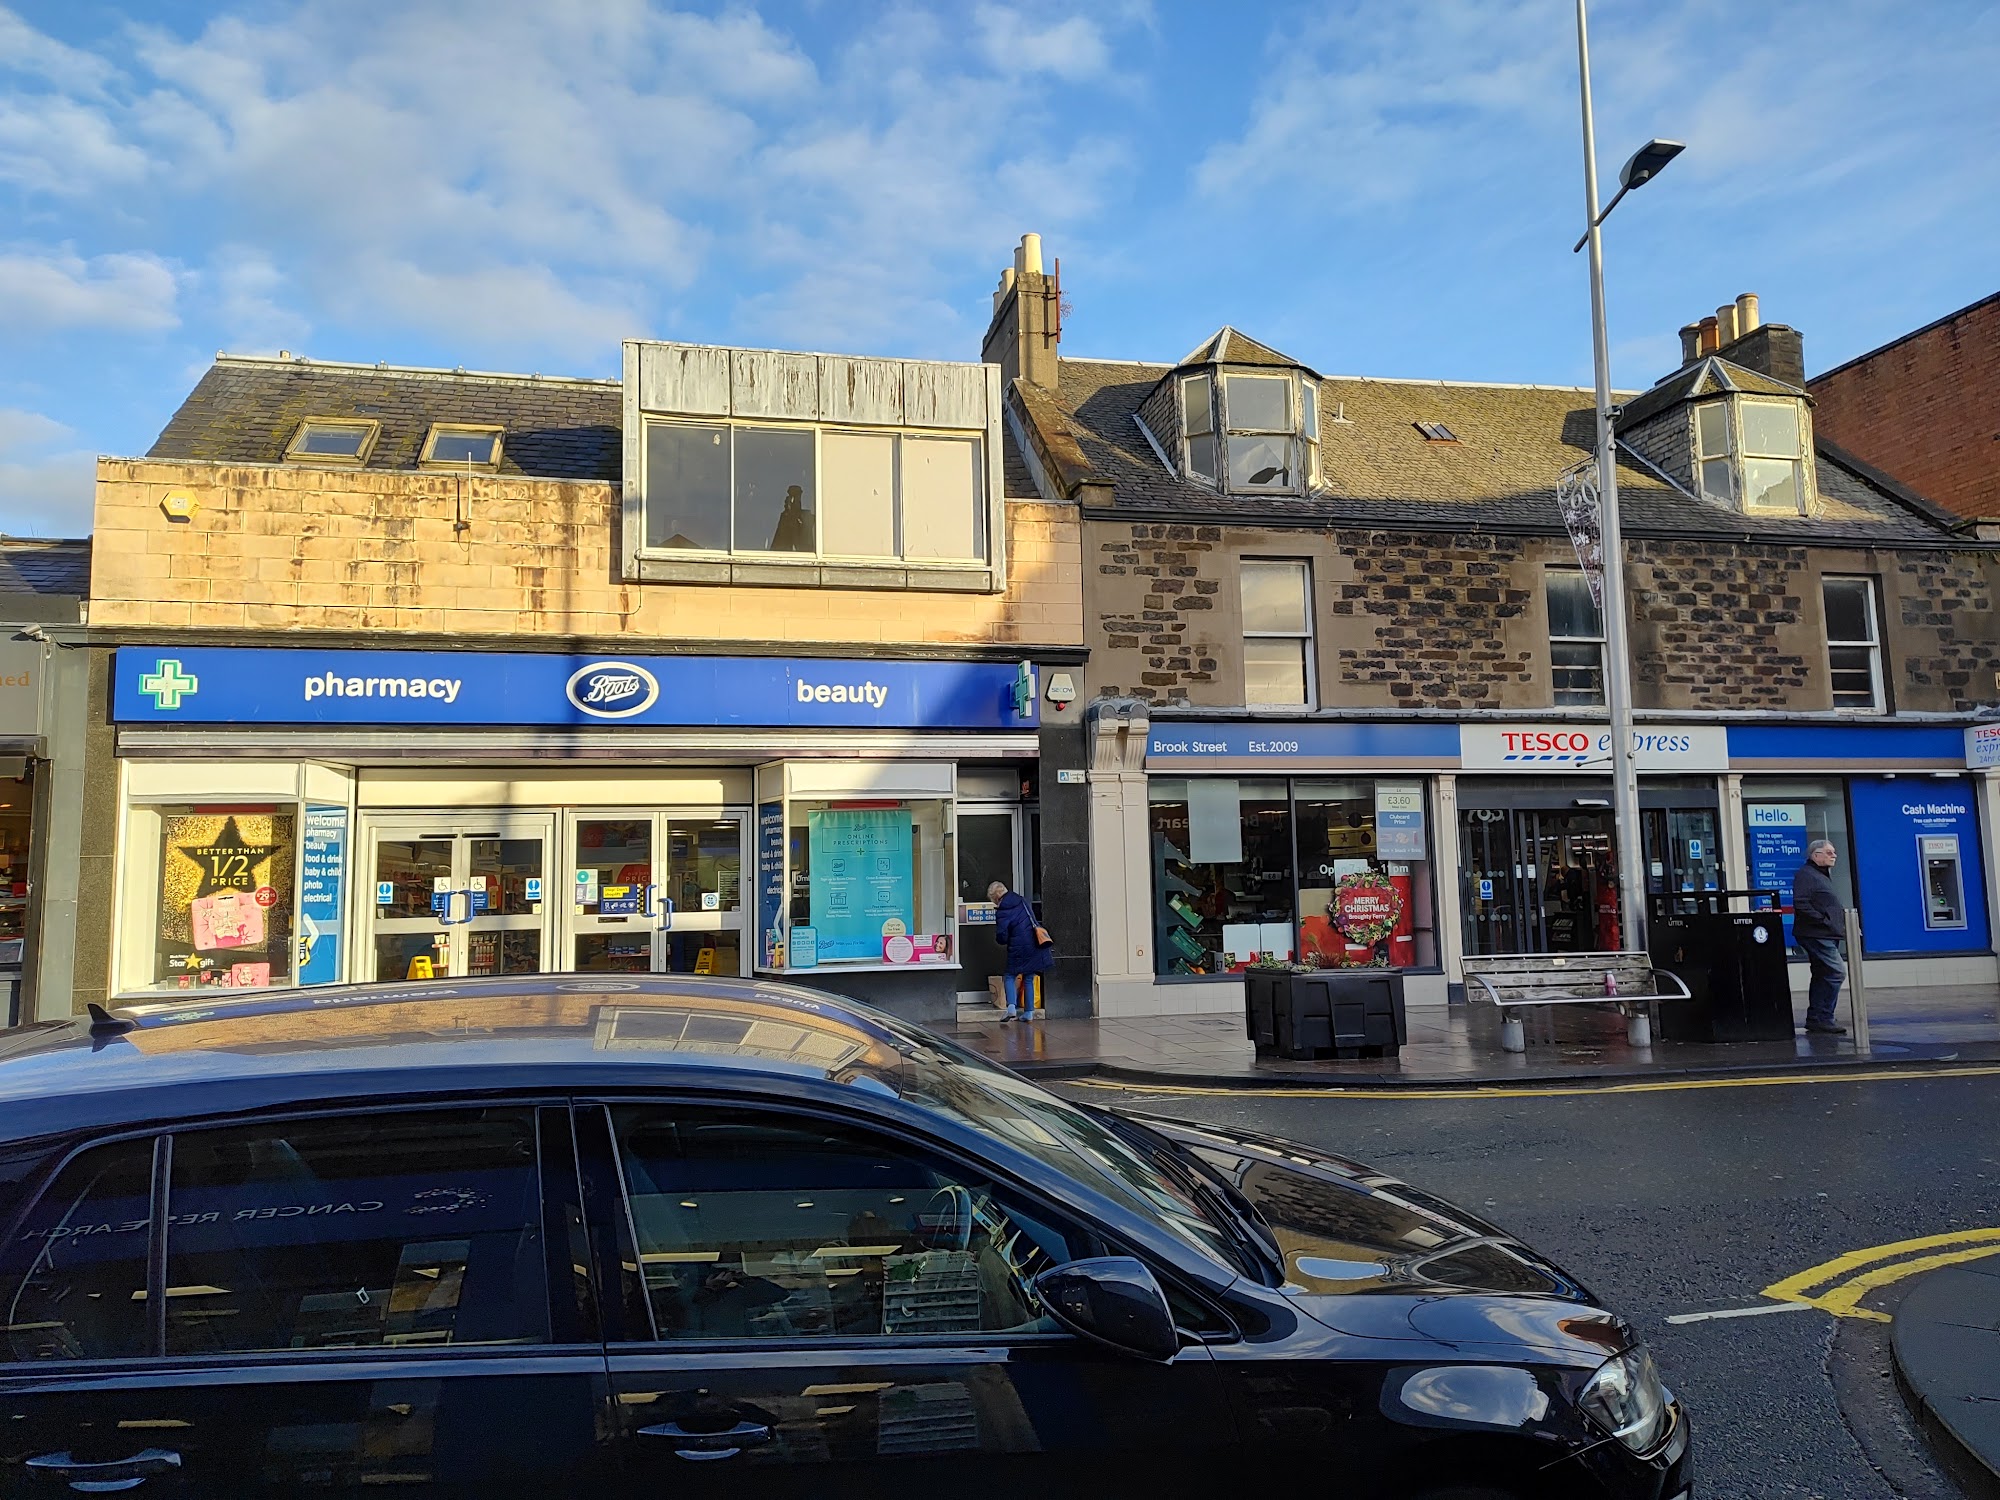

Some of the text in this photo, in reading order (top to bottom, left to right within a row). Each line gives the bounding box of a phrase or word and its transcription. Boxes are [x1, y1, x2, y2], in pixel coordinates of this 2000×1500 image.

[304, 671, 462, 704] pharmacy
[582, 675, 640, 703] Boots
[797, 679, 888, 708] beauty
[1153, 741, 1298, 752] Brook Street Est.2009
[1501, 731, 1690, 751] TESCO epress
[1387, 796, 1411, 805] £3.60
[1902, 804, 1926, 815] Cash
[306, 814, 346, 827] welcome
[761, 814, 783, 825] welcome
[1755, 809, 1793, 822] Hello.
[305, 827, 337, 839] pharmacy
[765, 826, 783, 836] pharmacy
[305, 841, 328, 852] beauty
[770, 838, 783, 846] beauty
[237, 847, 264, 855] THAN
[761, 850, 770, 859] food
[774, 848, 783, 857] drink
[1757, 845, 1774, 854] 7am
[1781, 845, 1800, 855] 11pm
[304, 854, 343, 864] food & drink
[211, 855, 249, 877] 1/2
[761, 862, 771, 872] baby
[774, 860, 783, 870] child
[304, 867, 342, 878] baby & child
[772, 873, 783, 883] photo
[210, 877, 248, 886] PRICE
[303, 880, 323, 890] photo
[303, 893, 333, 903] electrical
[1354, 896, 1380, 905] MERRY
[1344, 904, 1390, 913] CHRISTMAS
[1348, 913, 1387, 921] Broughty Ferry
[169, 958, 214, 968] Star gift
